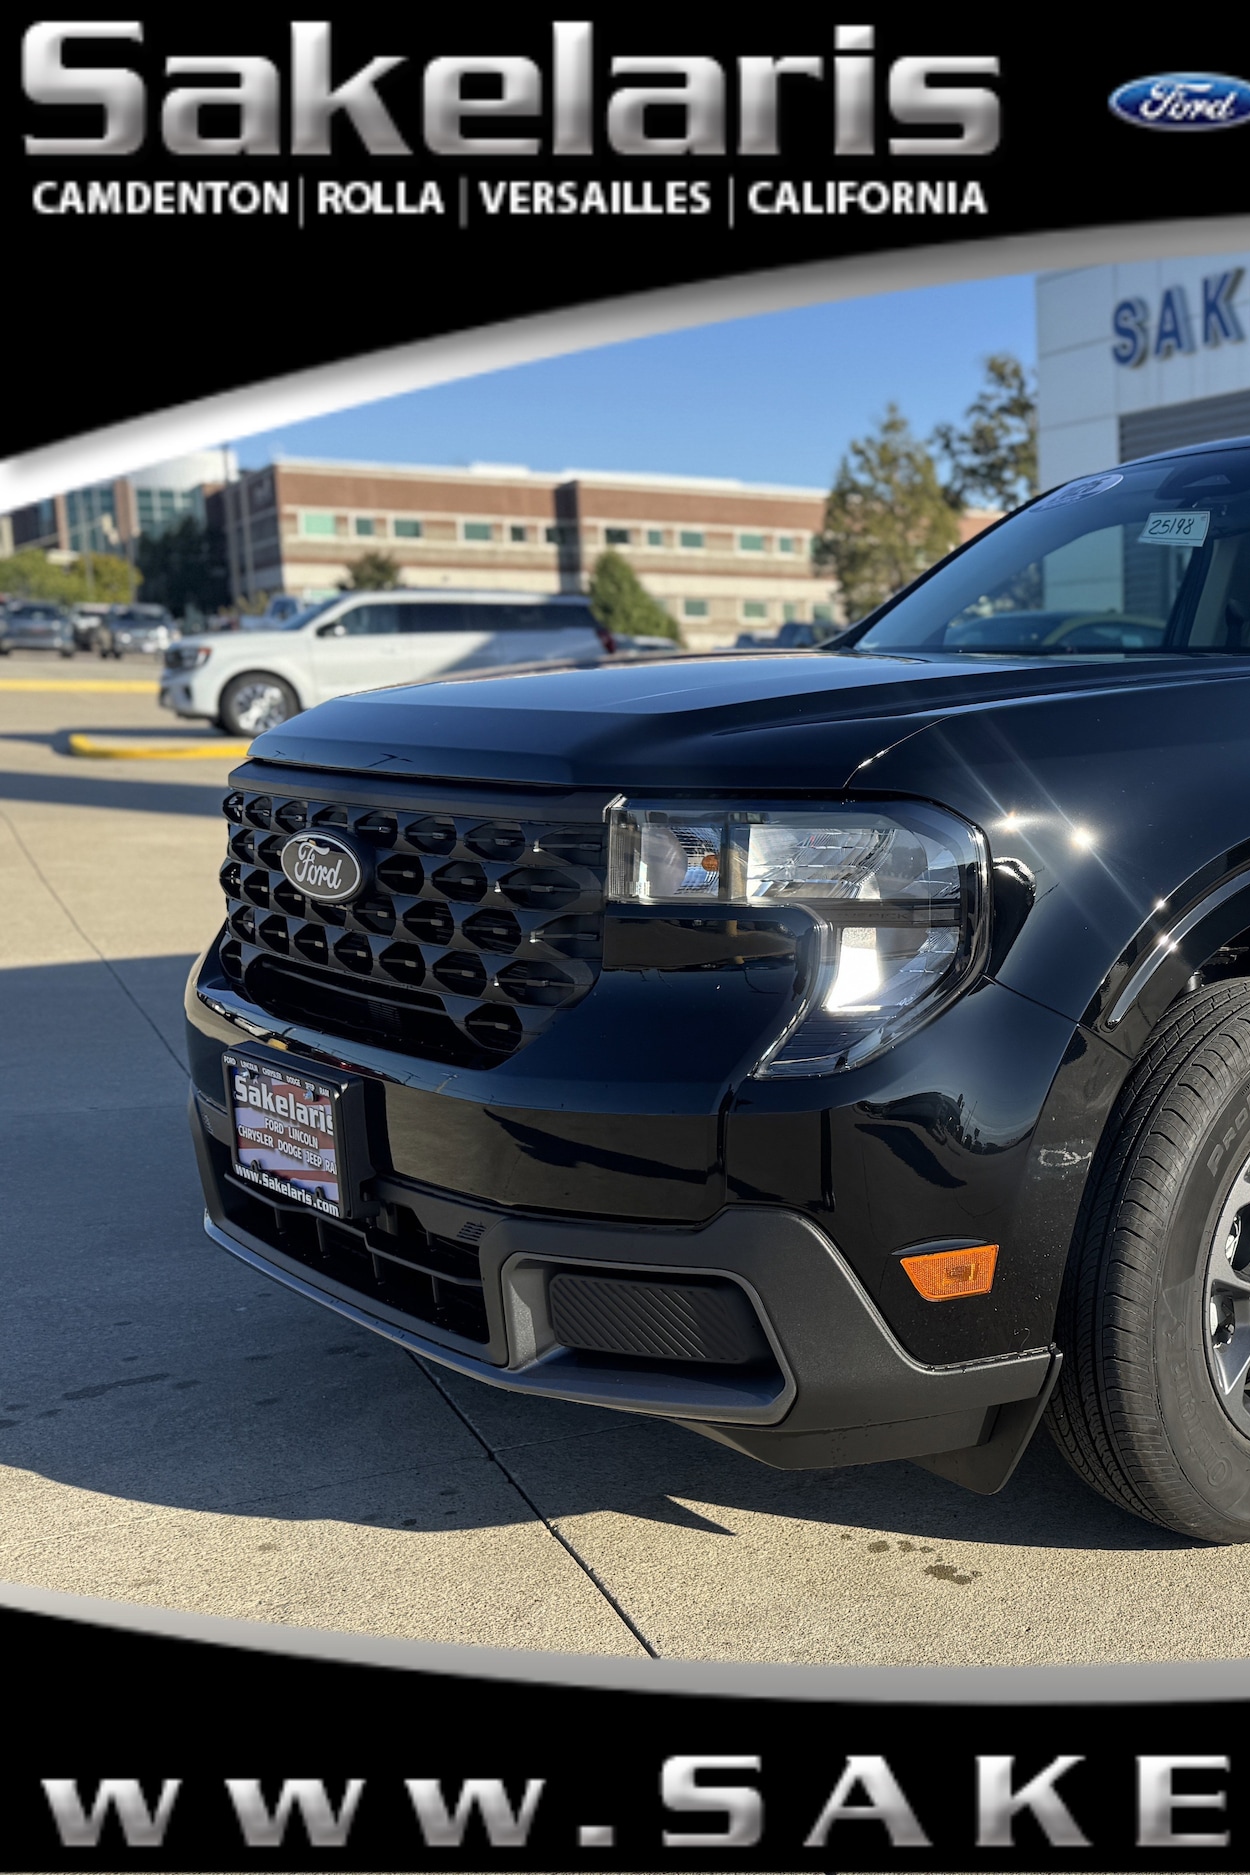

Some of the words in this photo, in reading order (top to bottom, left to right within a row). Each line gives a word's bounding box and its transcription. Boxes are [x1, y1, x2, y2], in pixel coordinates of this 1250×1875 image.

[1148, 518, 1195, 535] 25198
[294, 842, 342, 889] Ford
[234, 1074, 335, 1136] Sakelaris
[238, 1124, 274, 1148] CHRYSLER
[277, 1138, 303, 1160] DODGE
[305, 1150, 323, 1168] JEEP
[264, 1117, 285, 1135] FORD
[288, 1126, 319, 1149] LINCOLN
[234, 1164, 340, 1218] www.Sakelaris.com
